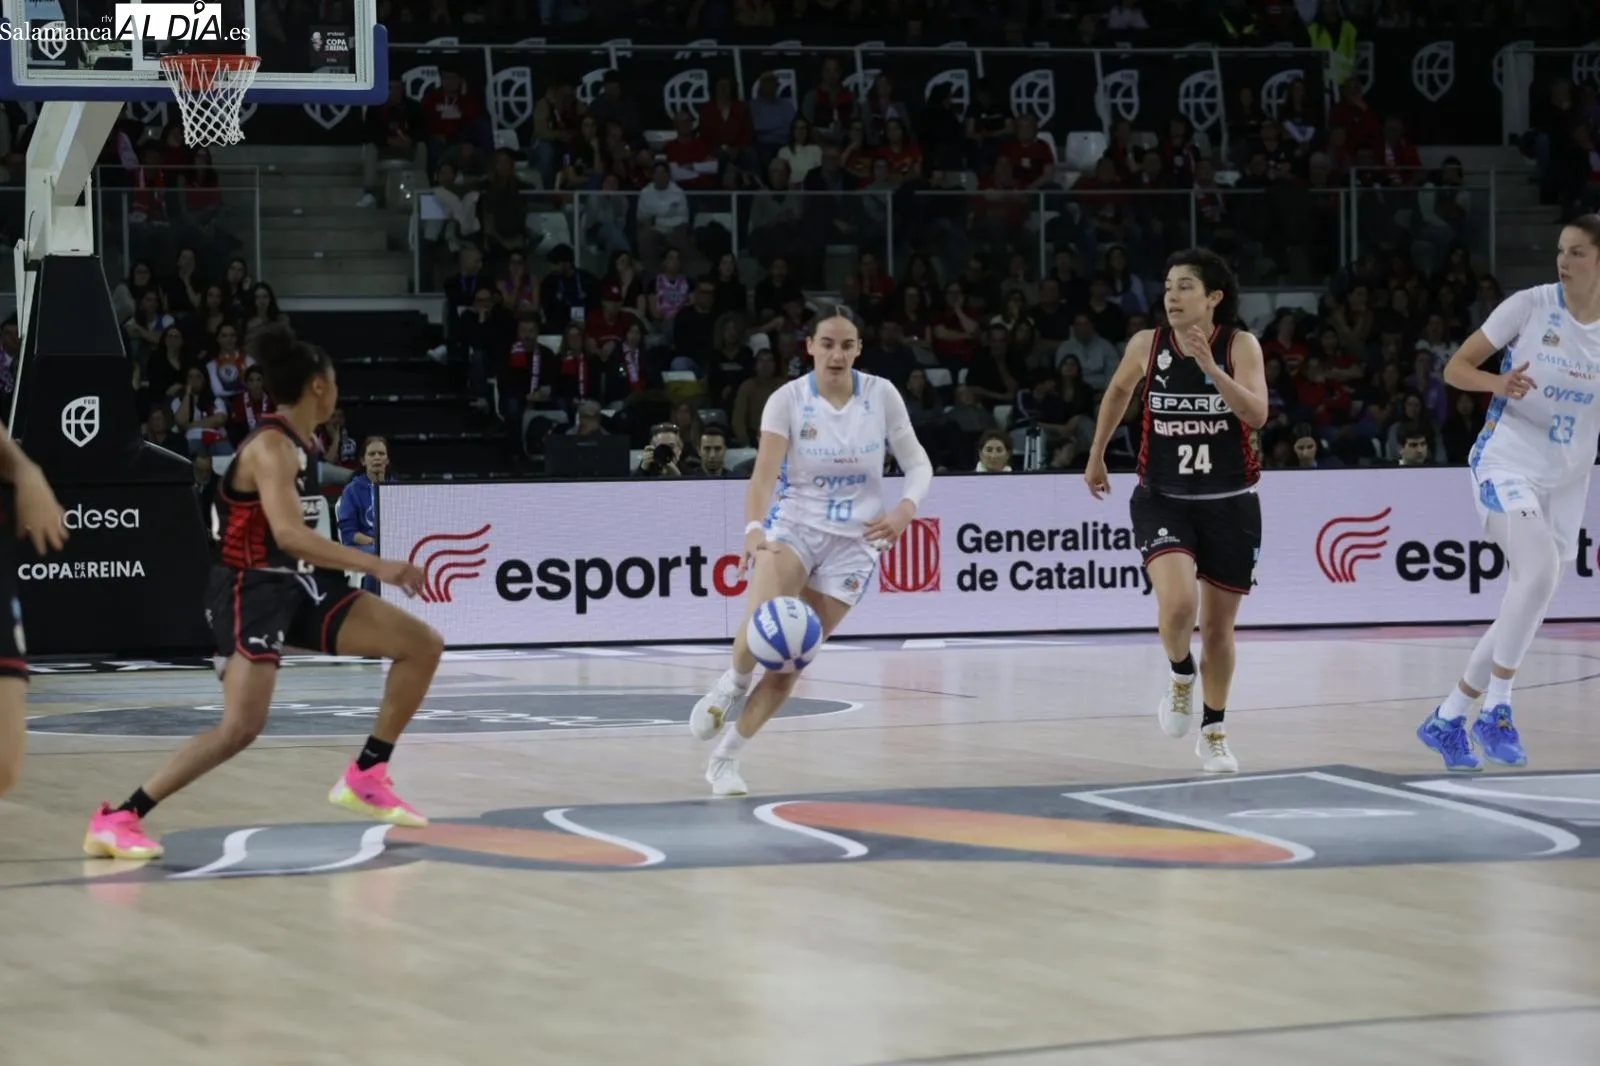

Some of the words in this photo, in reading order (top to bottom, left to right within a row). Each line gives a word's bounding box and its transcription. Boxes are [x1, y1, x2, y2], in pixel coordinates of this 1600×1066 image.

[1151, 396, 1209, 411] SPAR
[1153, 419, 1230, 437] GIRONA
[1548, 414, 1576, 444] 23
[1177, 443, 1213, 475] 24
[62, 503, 140, 529] desa
[826, 498, 854, 522] 10
[17, 563, 74, 580] COPA
[75, 562, 86, 570] DE
[87, 560, 146, 579] REINA
[1395, 528, 1600, 594] espt
[75, 570, 87, 579] LA
[495, 545, 749, 615] esportc
[956, 562, 998, 592] de
[1009, 560, 1153, 596] Cataluny
